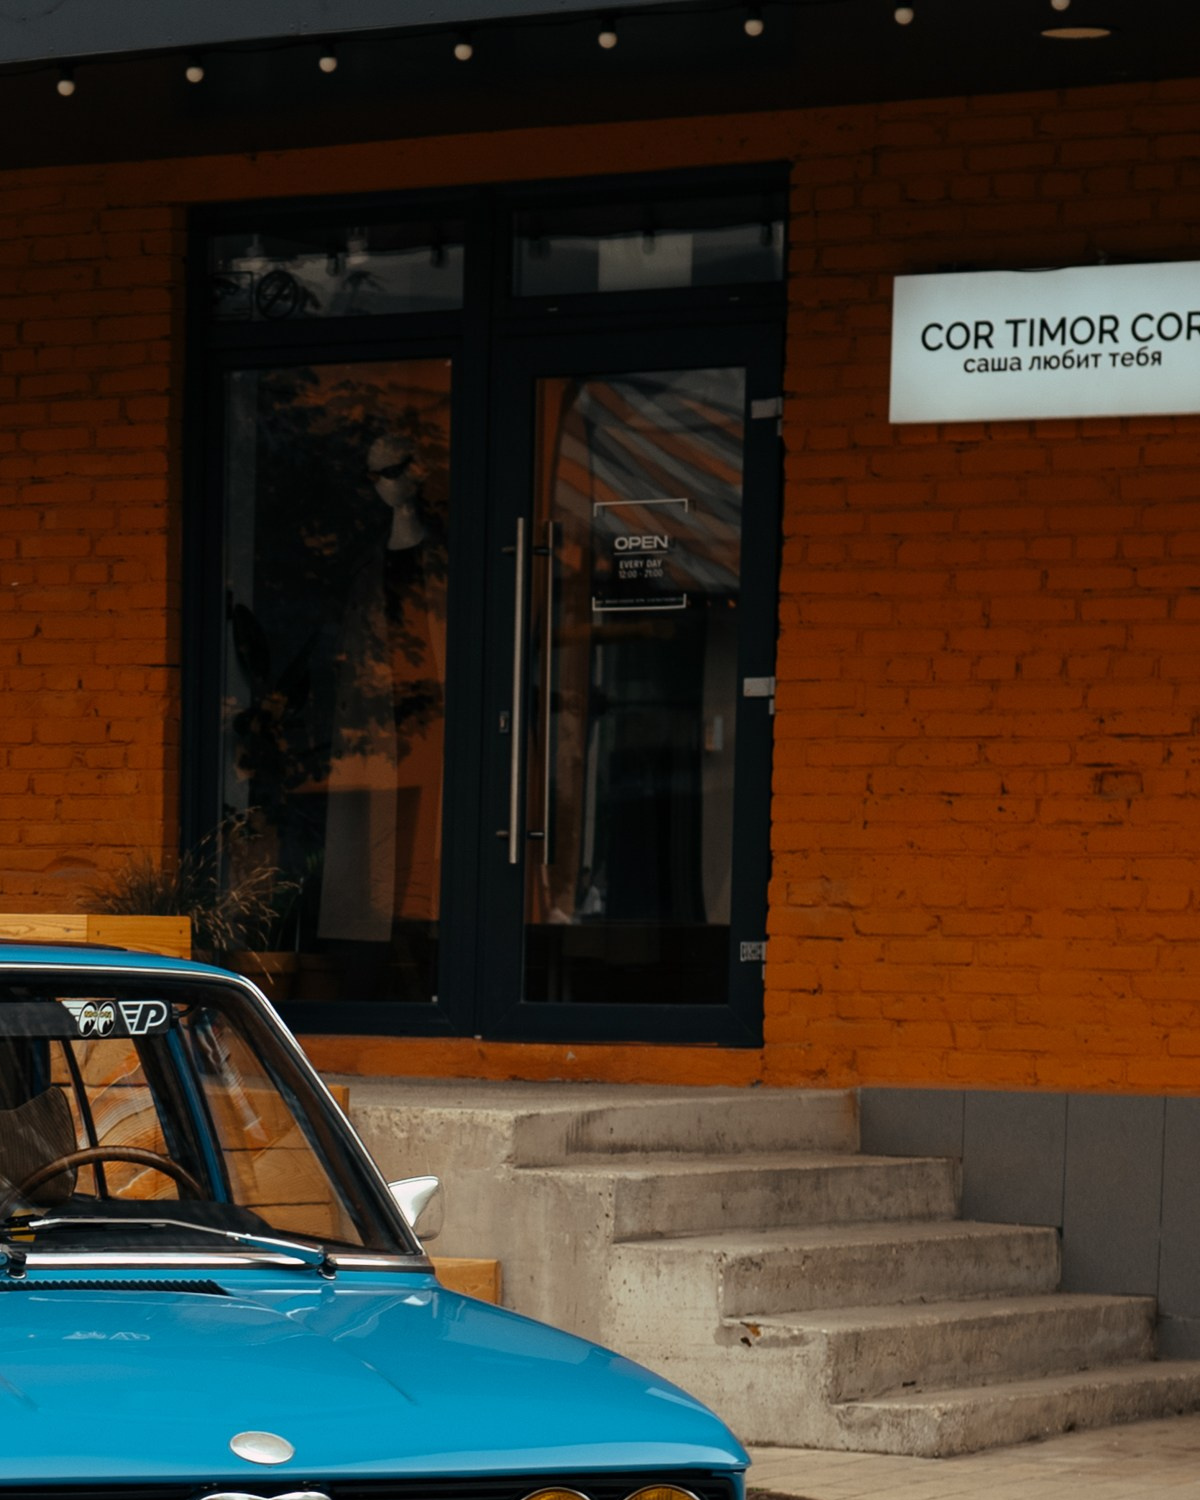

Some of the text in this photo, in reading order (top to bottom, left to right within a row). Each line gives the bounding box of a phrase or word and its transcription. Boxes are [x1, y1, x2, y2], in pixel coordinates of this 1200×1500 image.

[920, 320, 995, 352] COR
[1004, 314, 1120, 349] TIMOR
[962, 346, 1163, 374] саша любит тебя
[613, 534, 669, 551] OPEN
[619, 558, 663, 570] EVERY DAY
